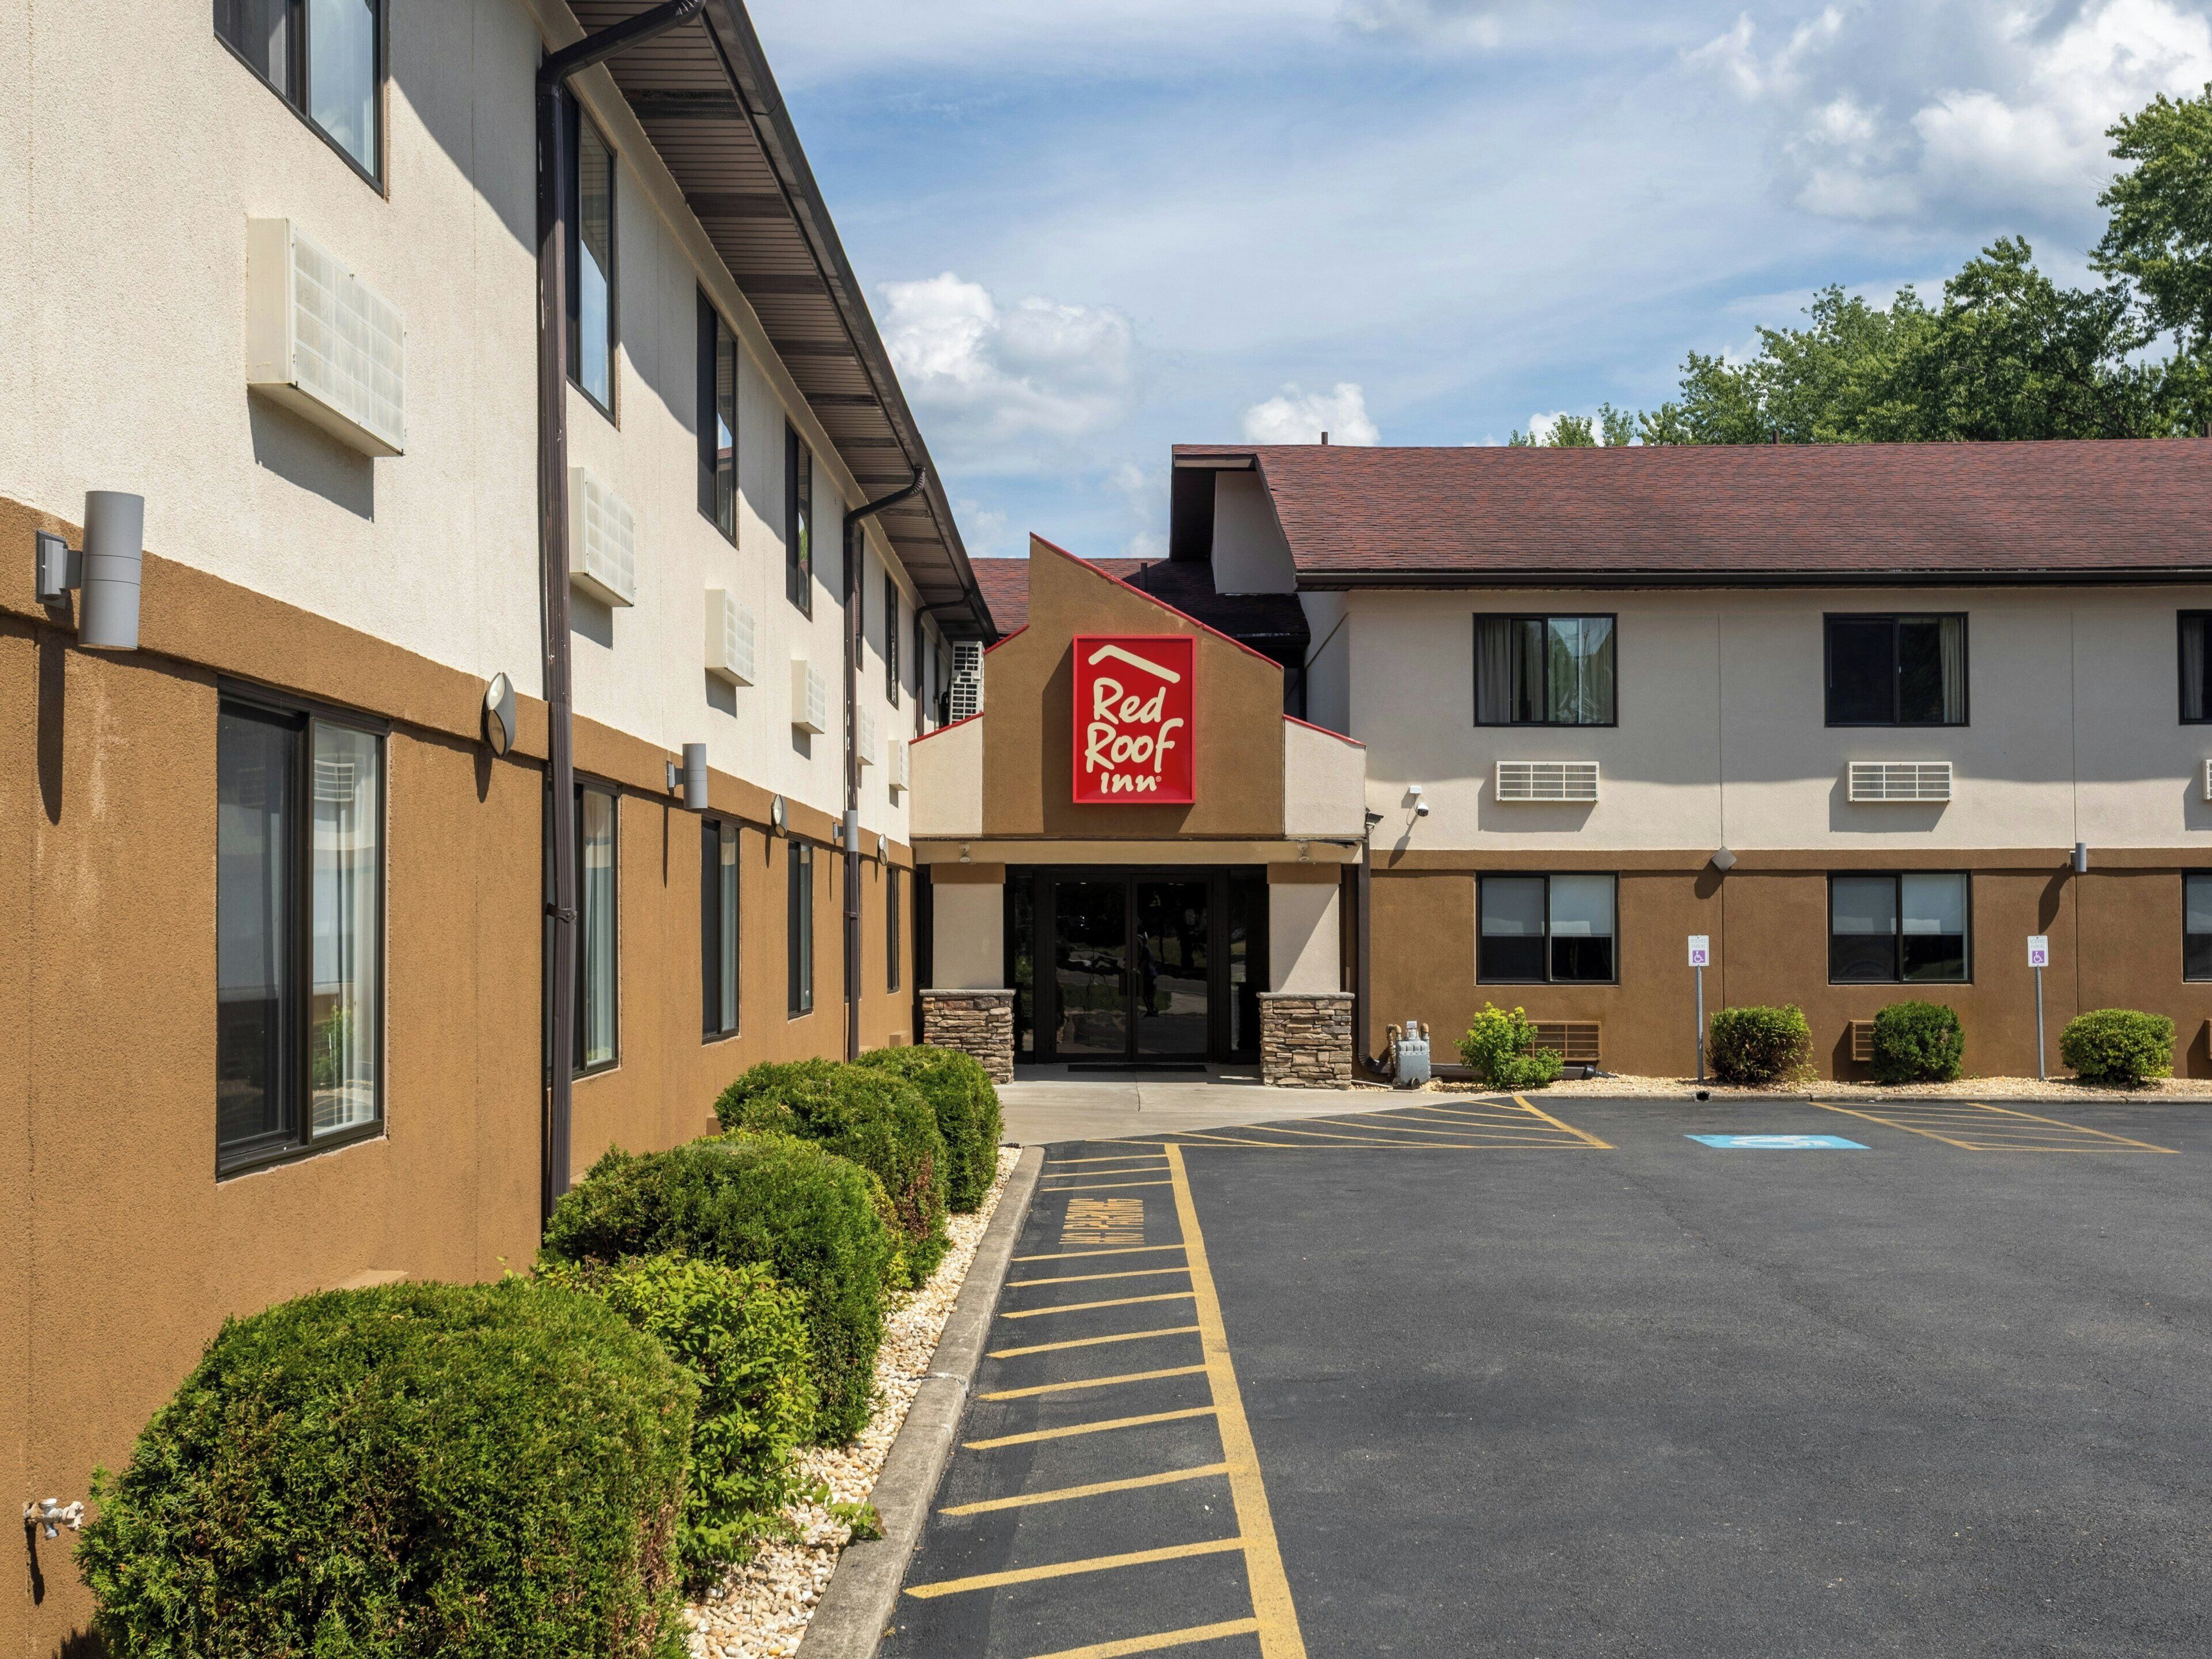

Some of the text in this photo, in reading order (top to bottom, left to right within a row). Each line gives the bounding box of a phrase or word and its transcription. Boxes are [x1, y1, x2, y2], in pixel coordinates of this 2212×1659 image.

[1093, 677, 1166, 725] Red
[1084, 718, 1184, 773] Roof
[1058, 1198, 1145, 1244] NO PARKING
